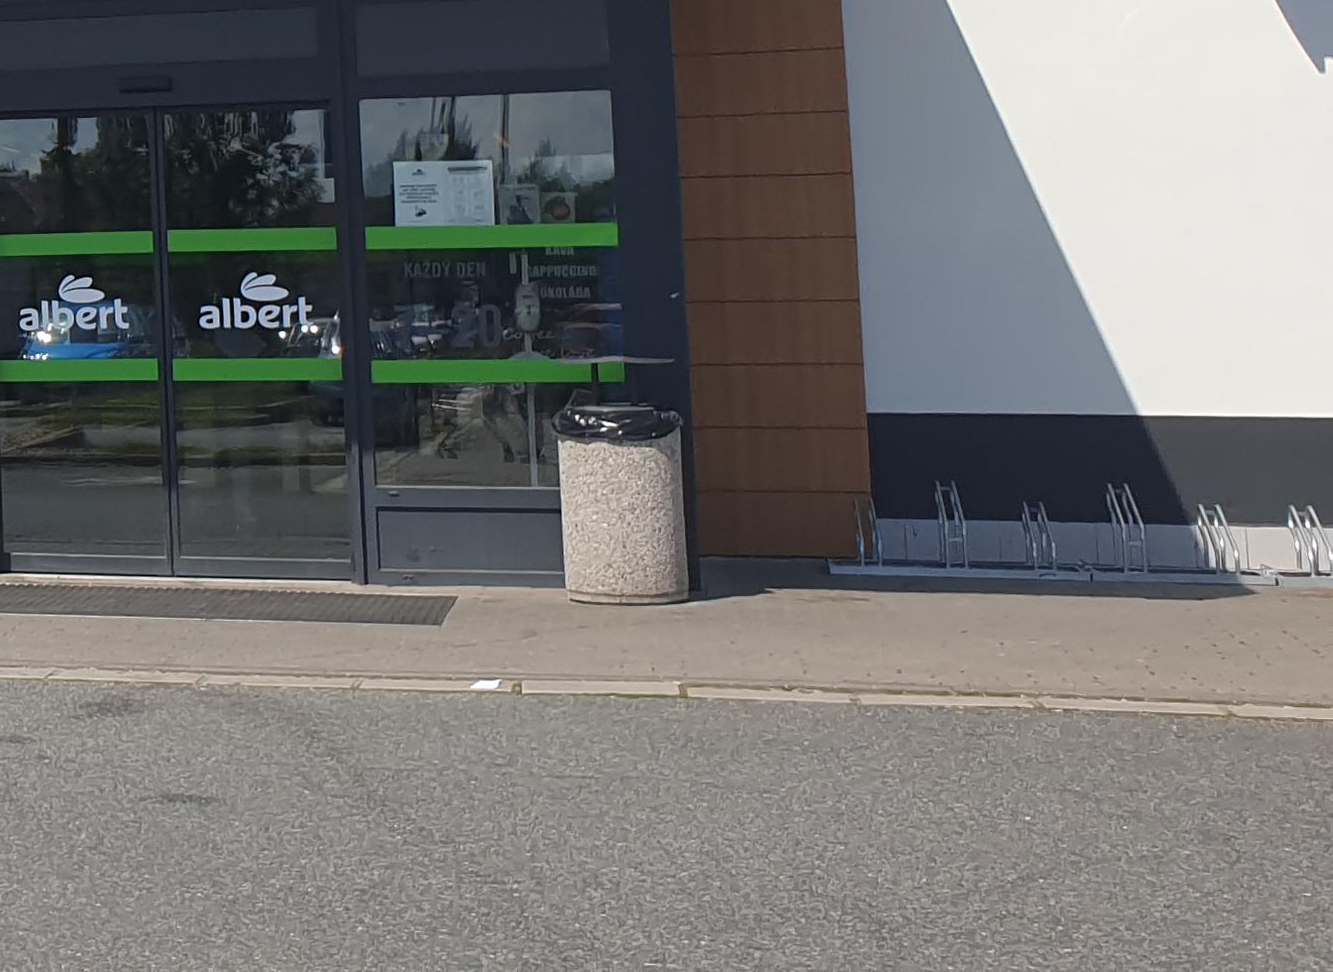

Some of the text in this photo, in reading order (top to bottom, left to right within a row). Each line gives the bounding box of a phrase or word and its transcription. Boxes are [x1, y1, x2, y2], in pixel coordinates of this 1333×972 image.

[456, 261, 486, 278] DEN
[540, 284, 591, 299] OKOLÁDA
[19, 299, 130, 331] albert
[199, 296, 313, 329] albert
